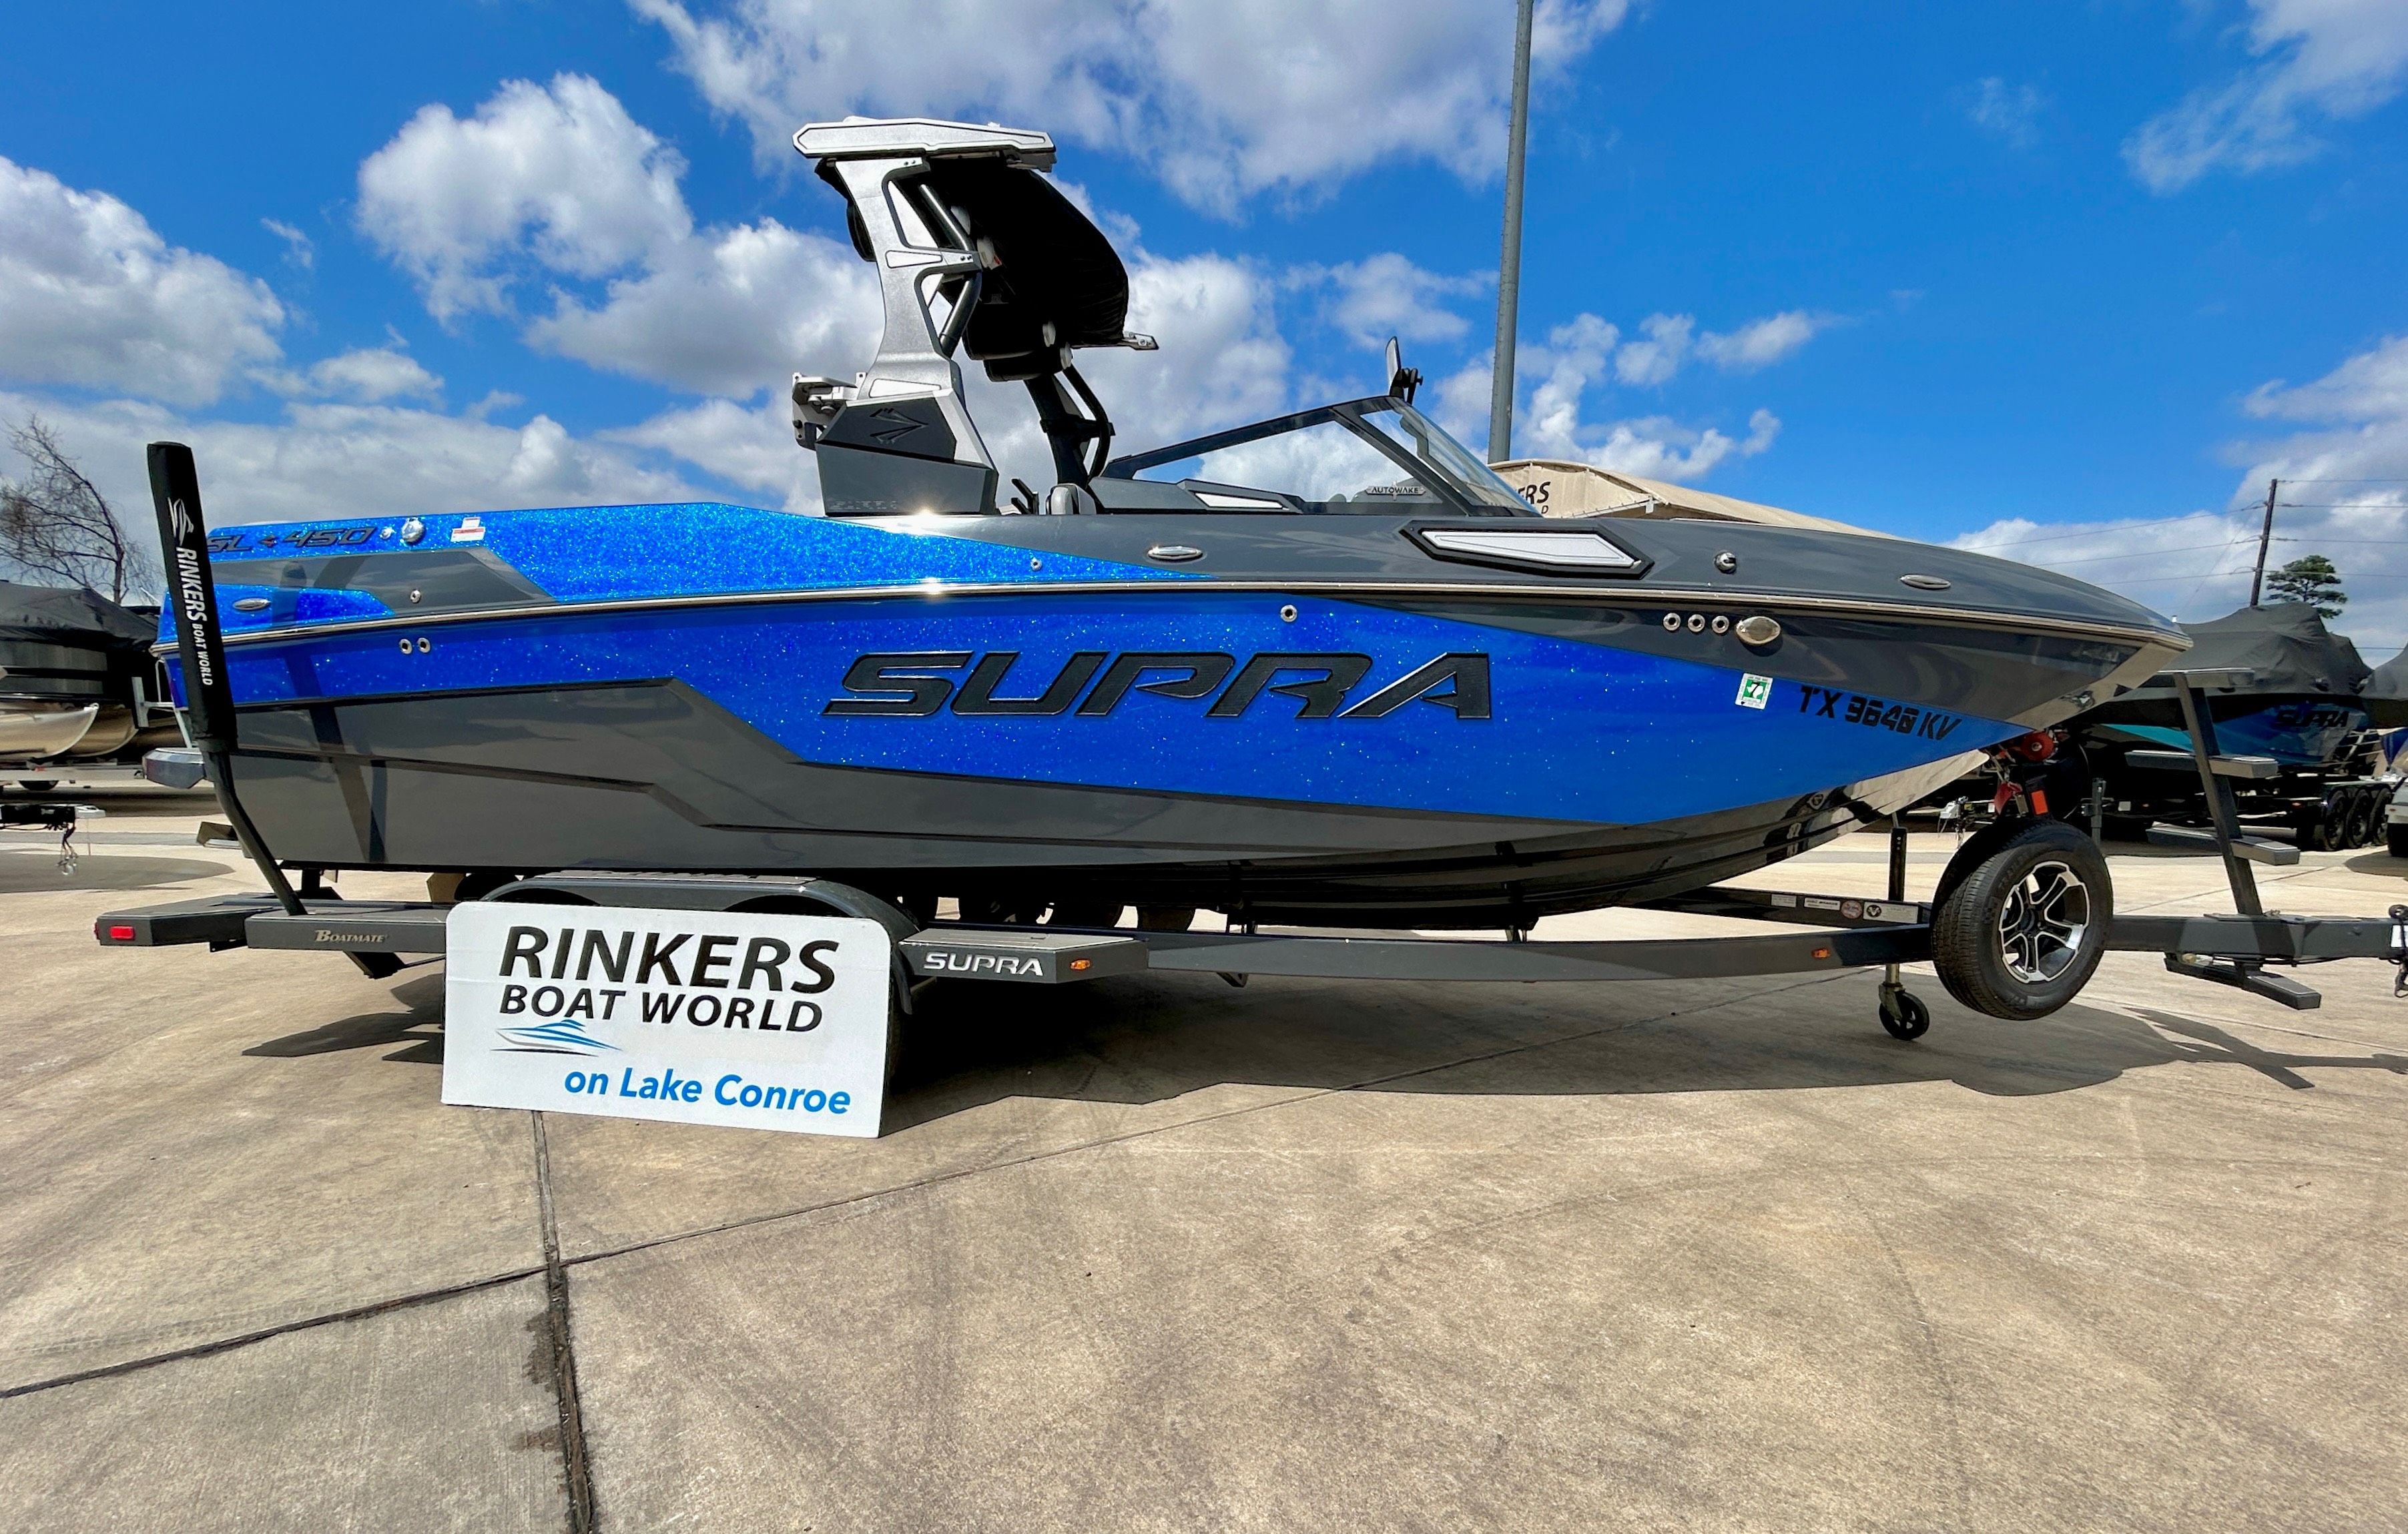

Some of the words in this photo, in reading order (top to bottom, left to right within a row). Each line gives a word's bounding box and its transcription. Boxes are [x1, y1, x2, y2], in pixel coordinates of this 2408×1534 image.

[206, 534, 252, 553] SL
[282, 526, 377, 548] 450
[176, 546, 208, 621] RINKERS
[192, 623, 207, 649] BOAT
[197, 650, 213, 685] WORLD
[822, 650, 1490, 719] SUPRA
[1800, 686, 1843, 719] TX
[1917, 712, 1963, 741] KV
[315, 929, 385, 943] BOATMATE
[499, 926, 840, 994] RINKERS
[923, 952, 1044, 976] SUPRA
[499, 986, 625, 1020] BOAT
[641, 993, 823, 1032] WORLD
[565, 1070, 609, 1094] on
[619, 1068, 702, 1102] Lake
[715, 1074, 851, 1114] Conroe
